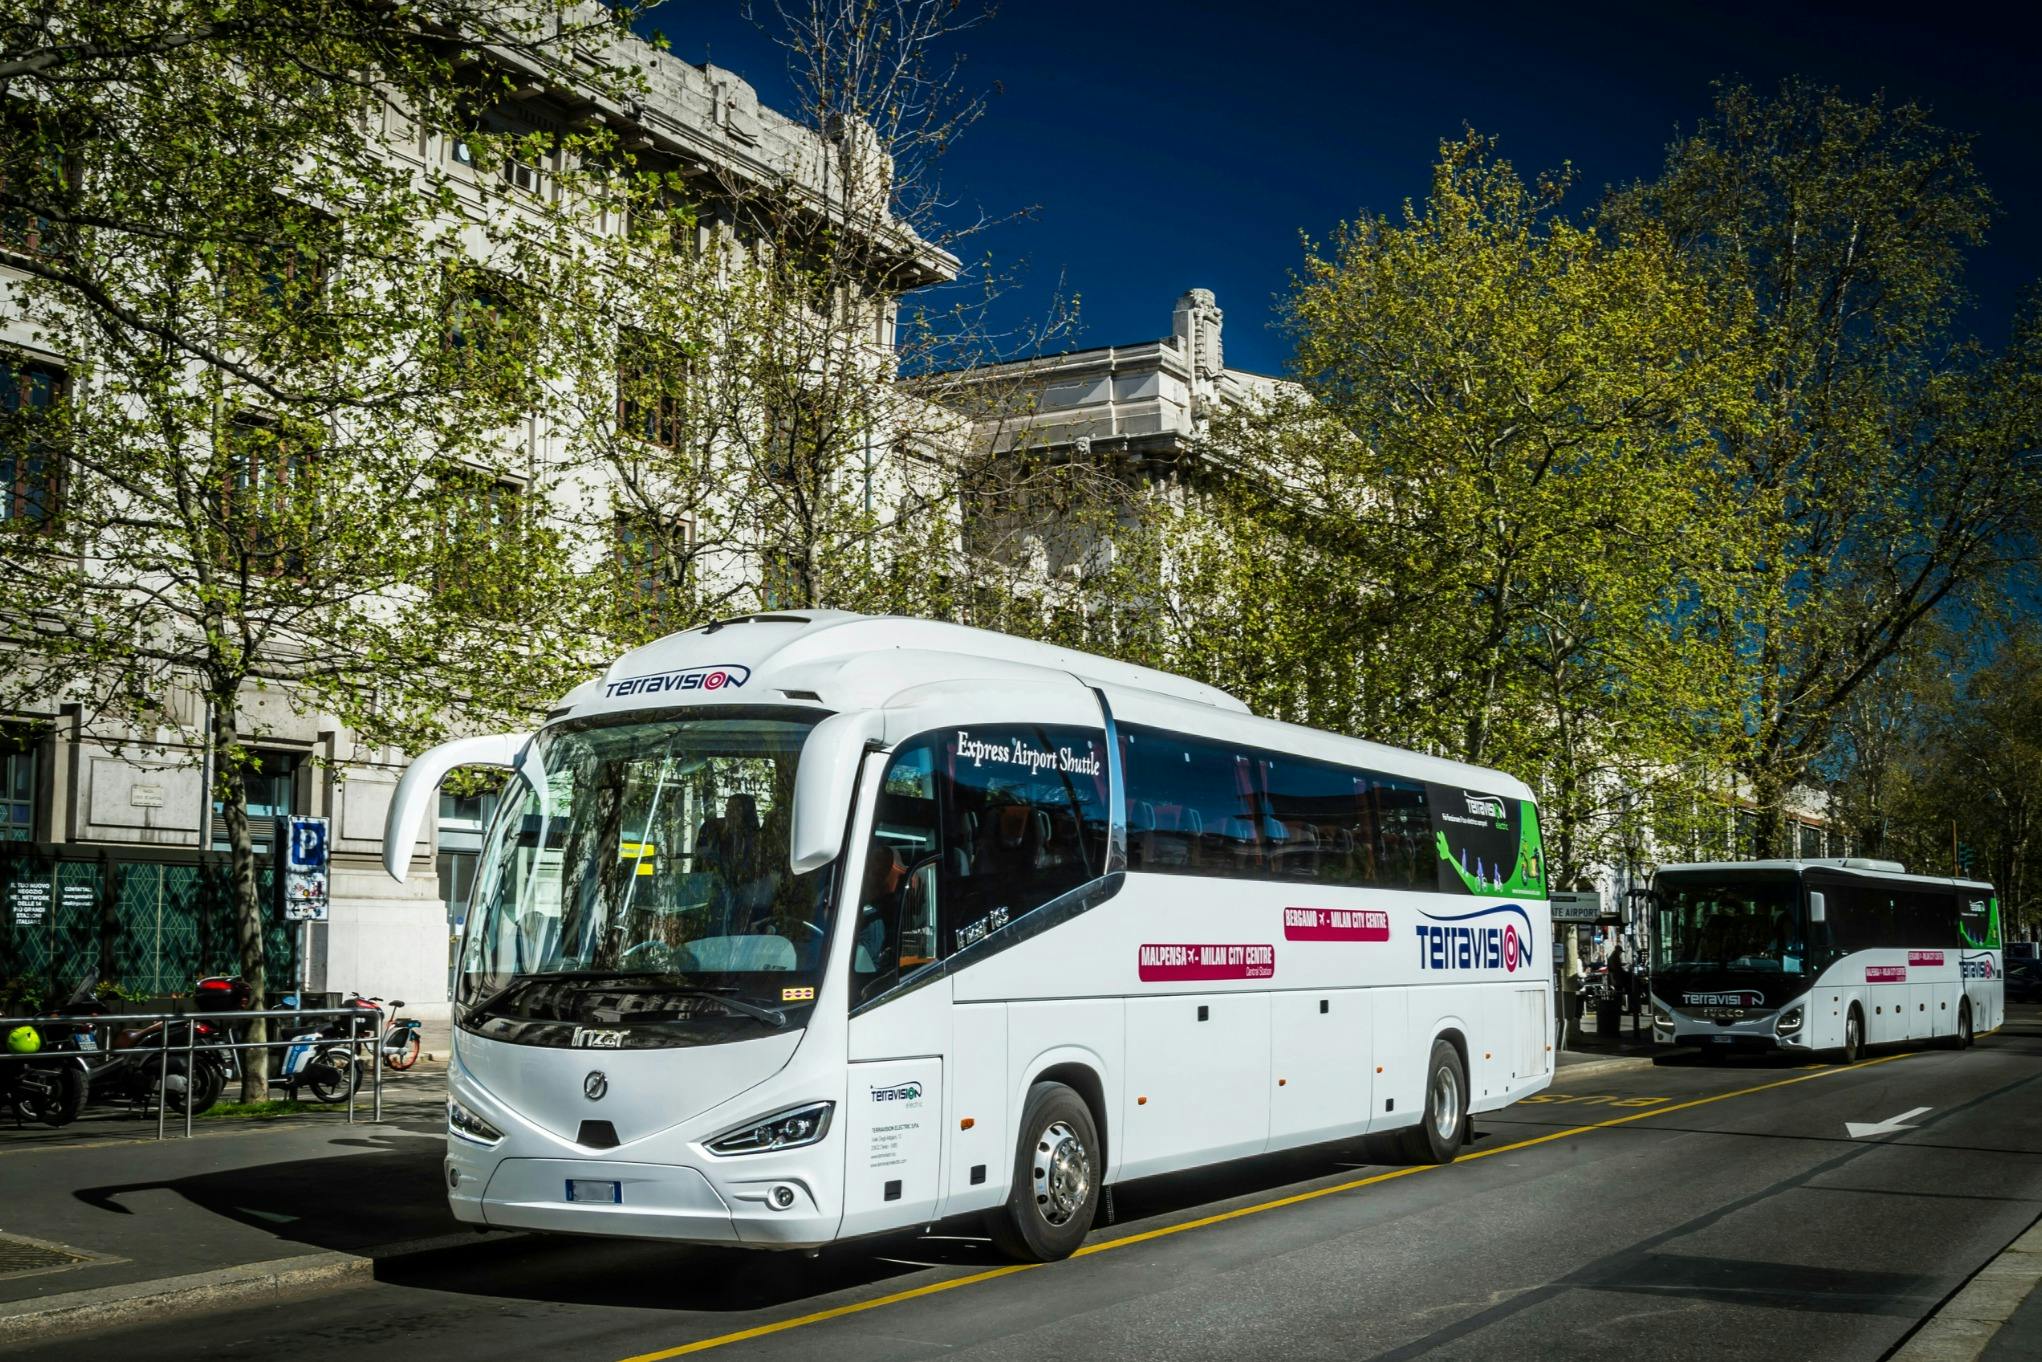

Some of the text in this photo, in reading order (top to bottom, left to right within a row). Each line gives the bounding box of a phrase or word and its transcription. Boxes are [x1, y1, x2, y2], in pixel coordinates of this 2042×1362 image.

[957, 731, 1100, 776] Express Airport Shuttle
[299, 828, 318, 859] P
[1285, 909, 1388, 928] BERGAMO MILAN CITY CENTRE
[1565, 907, 1599, 918] AIRPORT
[1141, 946, 1272, 966] MALPENSA MILAN CITY CENTRE
[1703, 1008, 1745, 1018] IVECO
